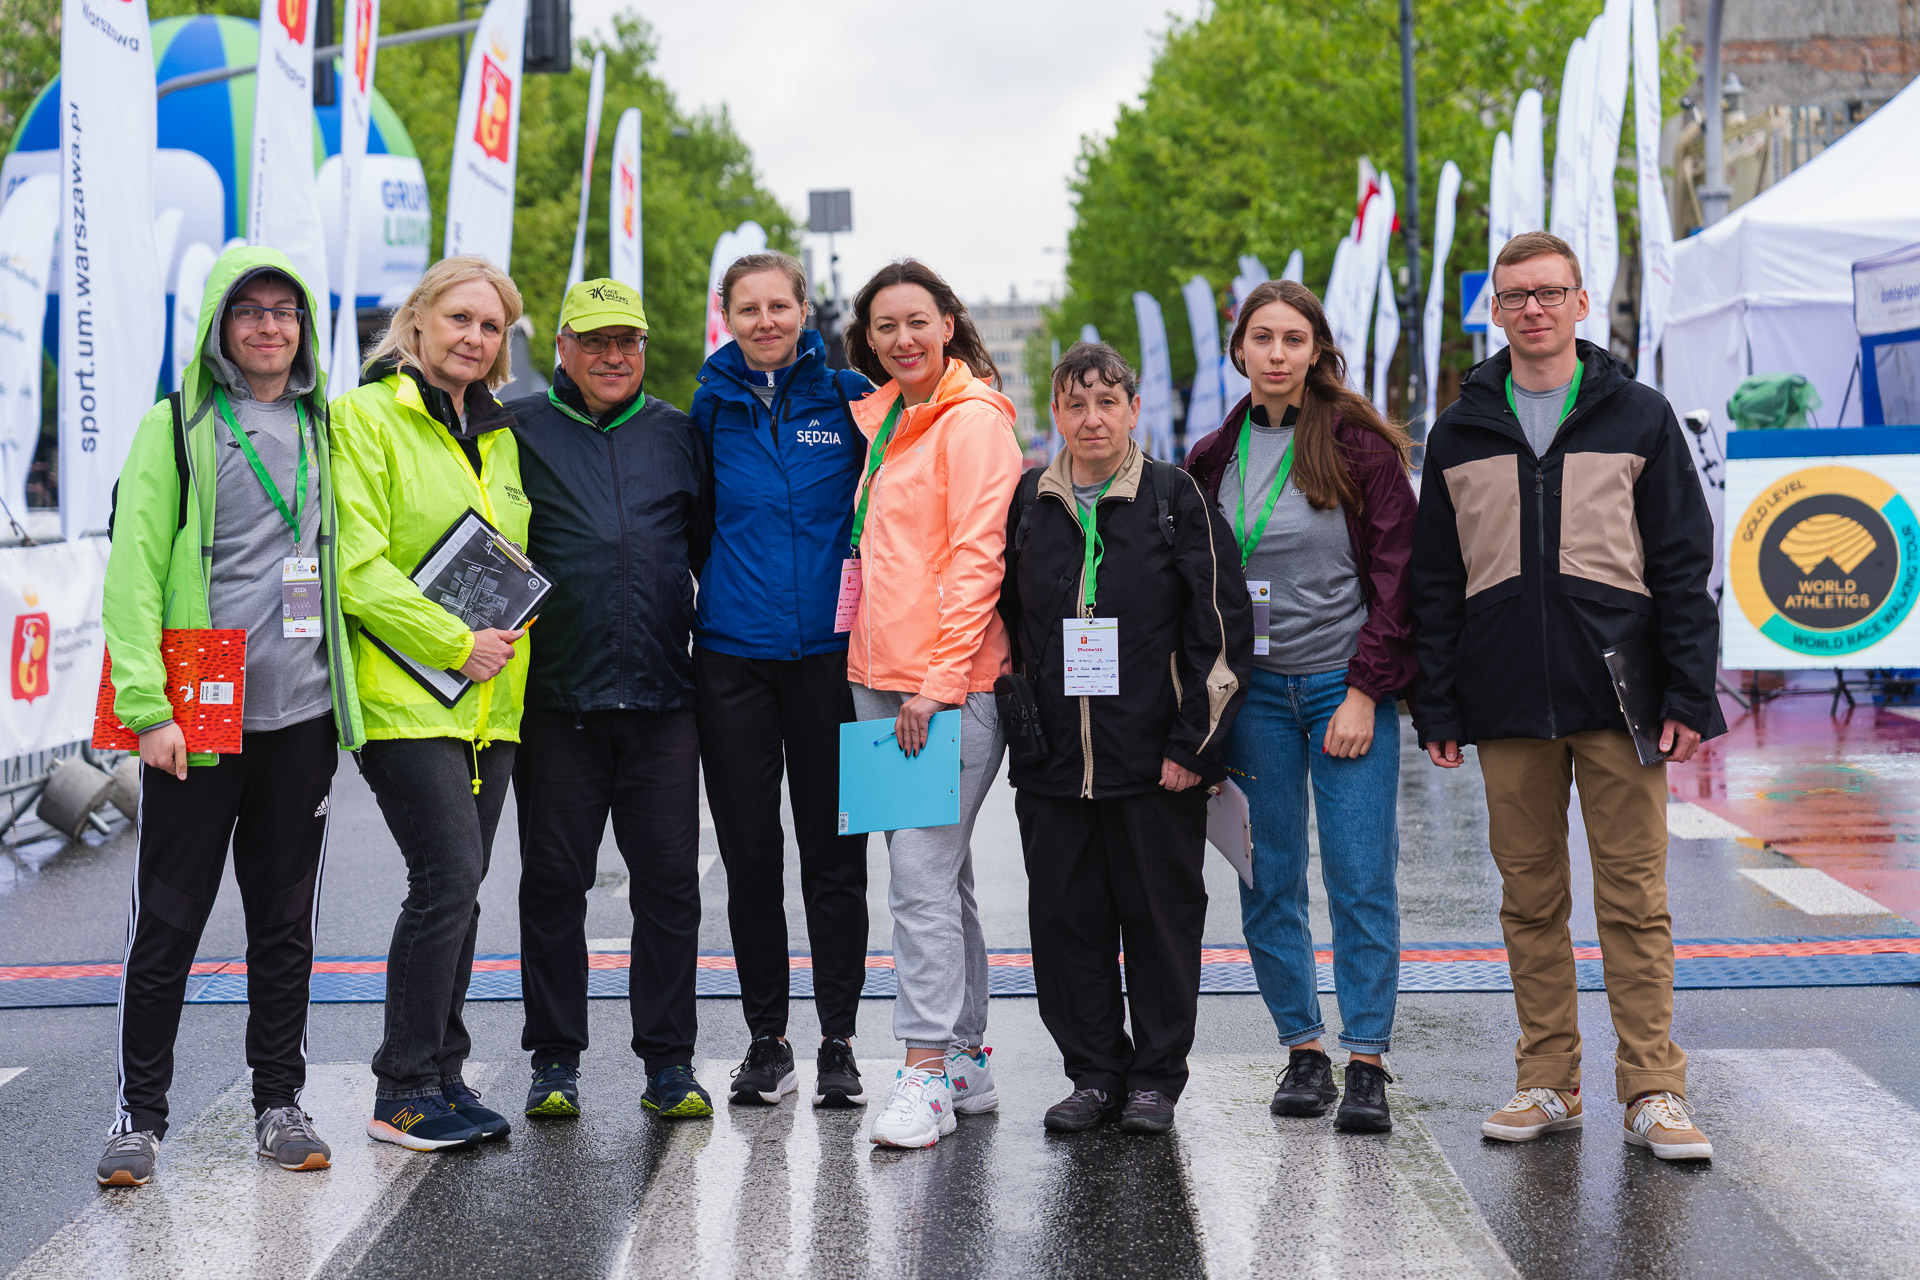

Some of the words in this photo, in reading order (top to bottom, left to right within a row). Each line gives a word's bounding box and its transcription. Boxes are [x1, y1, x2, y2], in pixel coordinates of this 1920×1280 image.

[69, 101, 101, 454] sport.um.warszawa.pl
[796, 430, 842, 447] SĘDZIA
[1742, 505, 1768, 543] GOLD
[1768, 478, 1807, 506] LEVEL
[1784, 593, 1871, 610] ATHLETICS
[1792, 631, 1844, 650] WORLD
[1846, 620, 1884, 646] RACE
[1883, 563, 1918, 625] WALKING
[1901, 522, 1919, 562] TOUR
[1798, 579, 1857, 594] WORLD
